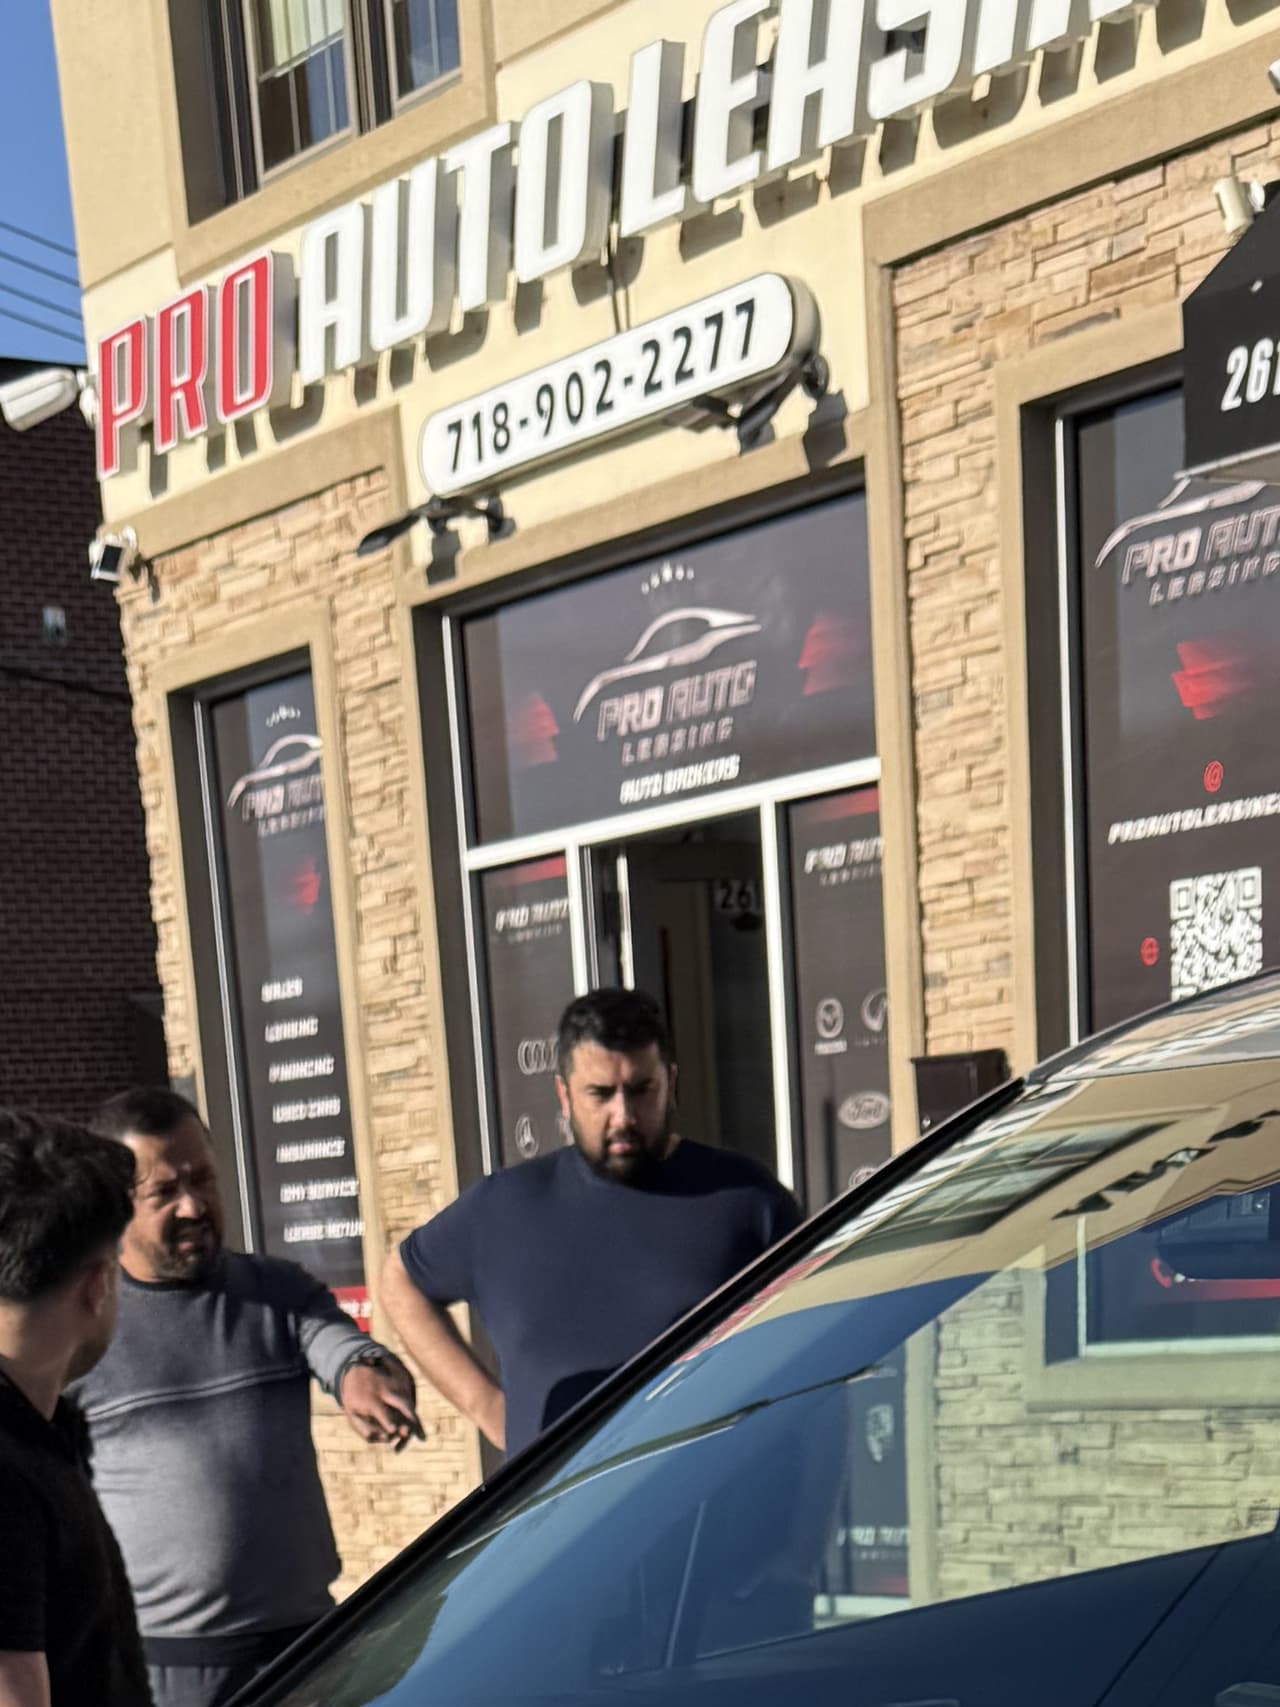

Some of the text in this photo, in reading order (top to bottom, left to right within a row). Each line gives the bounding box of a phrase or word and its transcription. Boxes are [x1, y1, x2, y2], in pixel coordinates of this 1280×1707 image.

[96, 248, 273, 480] PRO
[299, 80, 591, 386] AUTO
[447, 299, 757, 473] 718-902-2277
[1122, 526, 1202, 585] PRO
[597, 660, 758, 742] PRO AUTO
